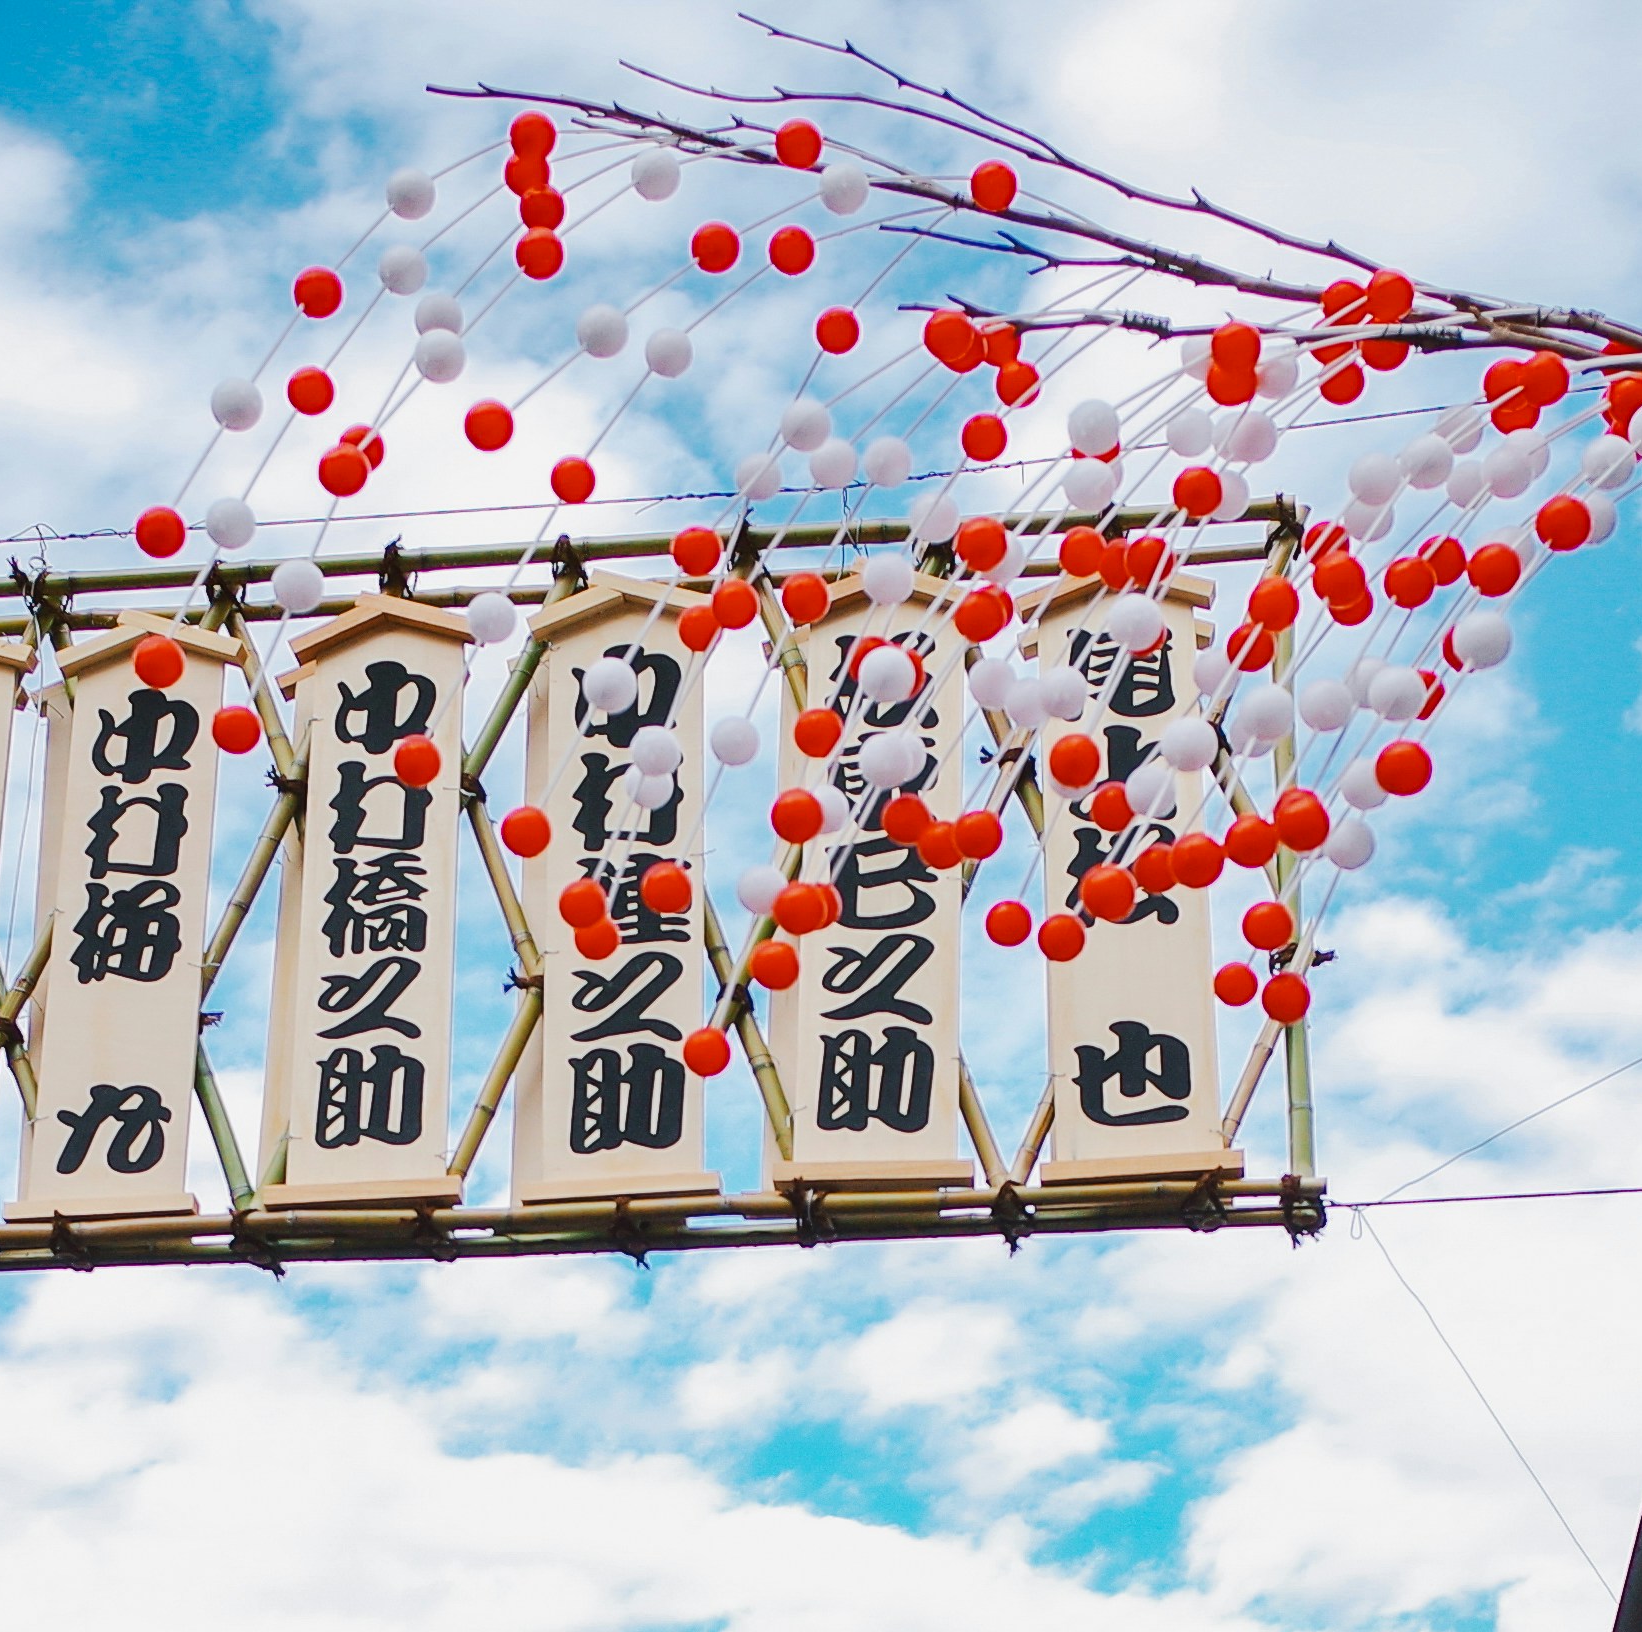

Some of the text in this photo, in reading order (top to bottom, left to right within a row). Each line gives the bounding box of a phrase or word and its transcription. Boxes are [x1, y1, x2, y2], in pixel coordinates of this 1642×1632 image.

[314, 659, 438, 1149] 中村橋之助
